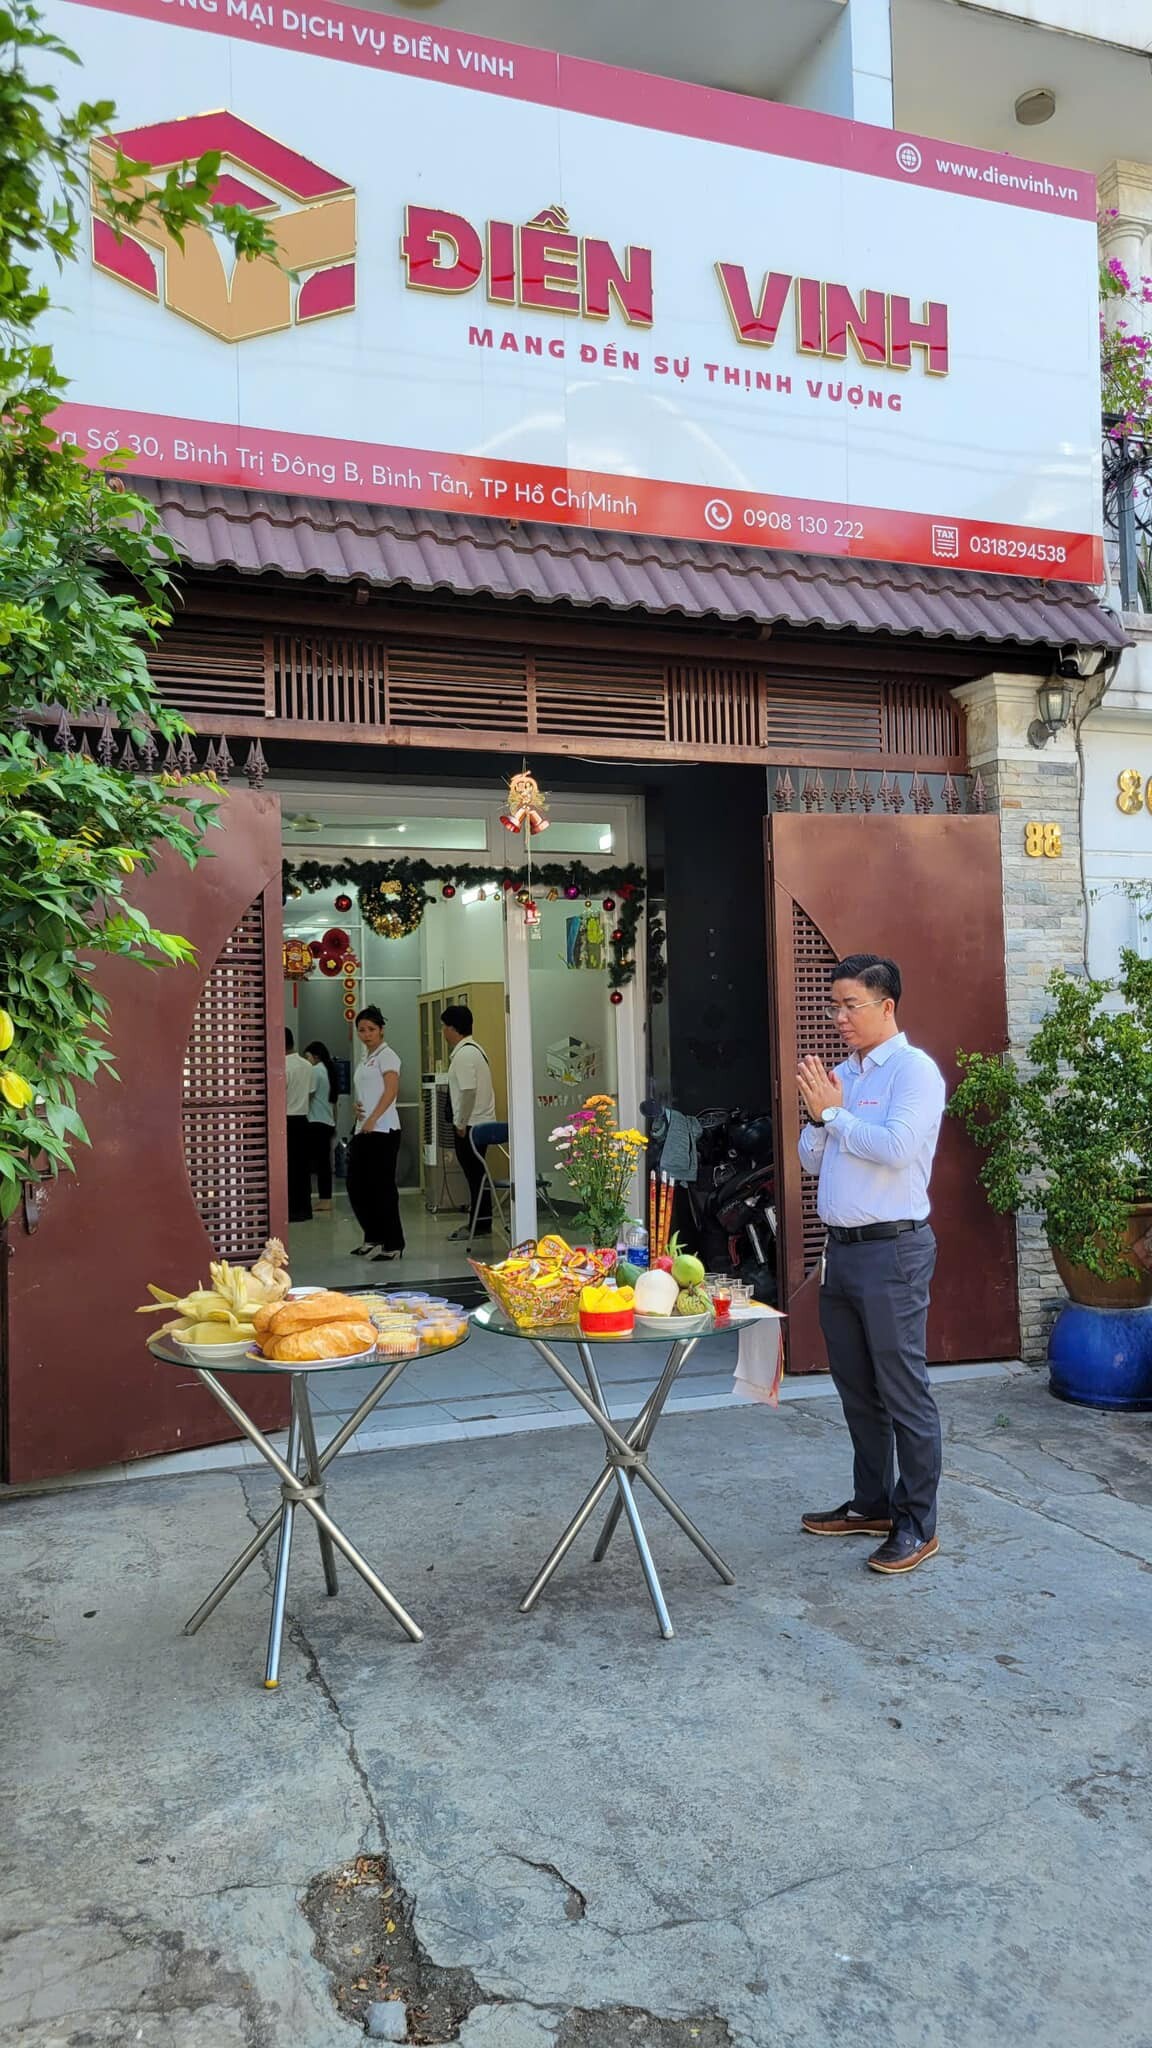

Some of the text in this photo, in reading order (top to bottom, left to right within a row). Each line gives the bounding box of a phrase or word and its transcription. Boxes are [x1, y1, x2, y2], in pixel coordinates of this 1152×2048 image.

[227, 0, 273, 29] MẠI
[282, 8, 344, 42] DỊCH
[351, 25, 386, 56] VỤ
[392, 33, 450, 65] ĐIỀN
[456, 48, 515, 80] VINH
[935, 158, 1078, 201] www.dienvinh.vn
[400, 203, 949, 377] ĐIỀN VINH
[468, 326, 902, 412] MANG ĐẾN SỰ THỊNH VƯỢNG
[87, 428, 120, 452] Số
[127, 434, 164, 462] 30,
[174, 439, 228, 467] Bình
[235, 447, 265, 477] Trị
[271, 451, 336, 485] Đông
[343, 461, 365, 486] B,
[371, 464, 422, 491] Bình
[428, 470, 474, 500] Tân,
[479, 478, 508, 500] TP
[514, 483, 546, 505] Hồ
[743, 508, 865, 540] 0908 130 222
[935, 527, 955, 541] TAX
[969, 535, 1067, 565] 0318294538
[1116, 767, 1152, 817] 8
